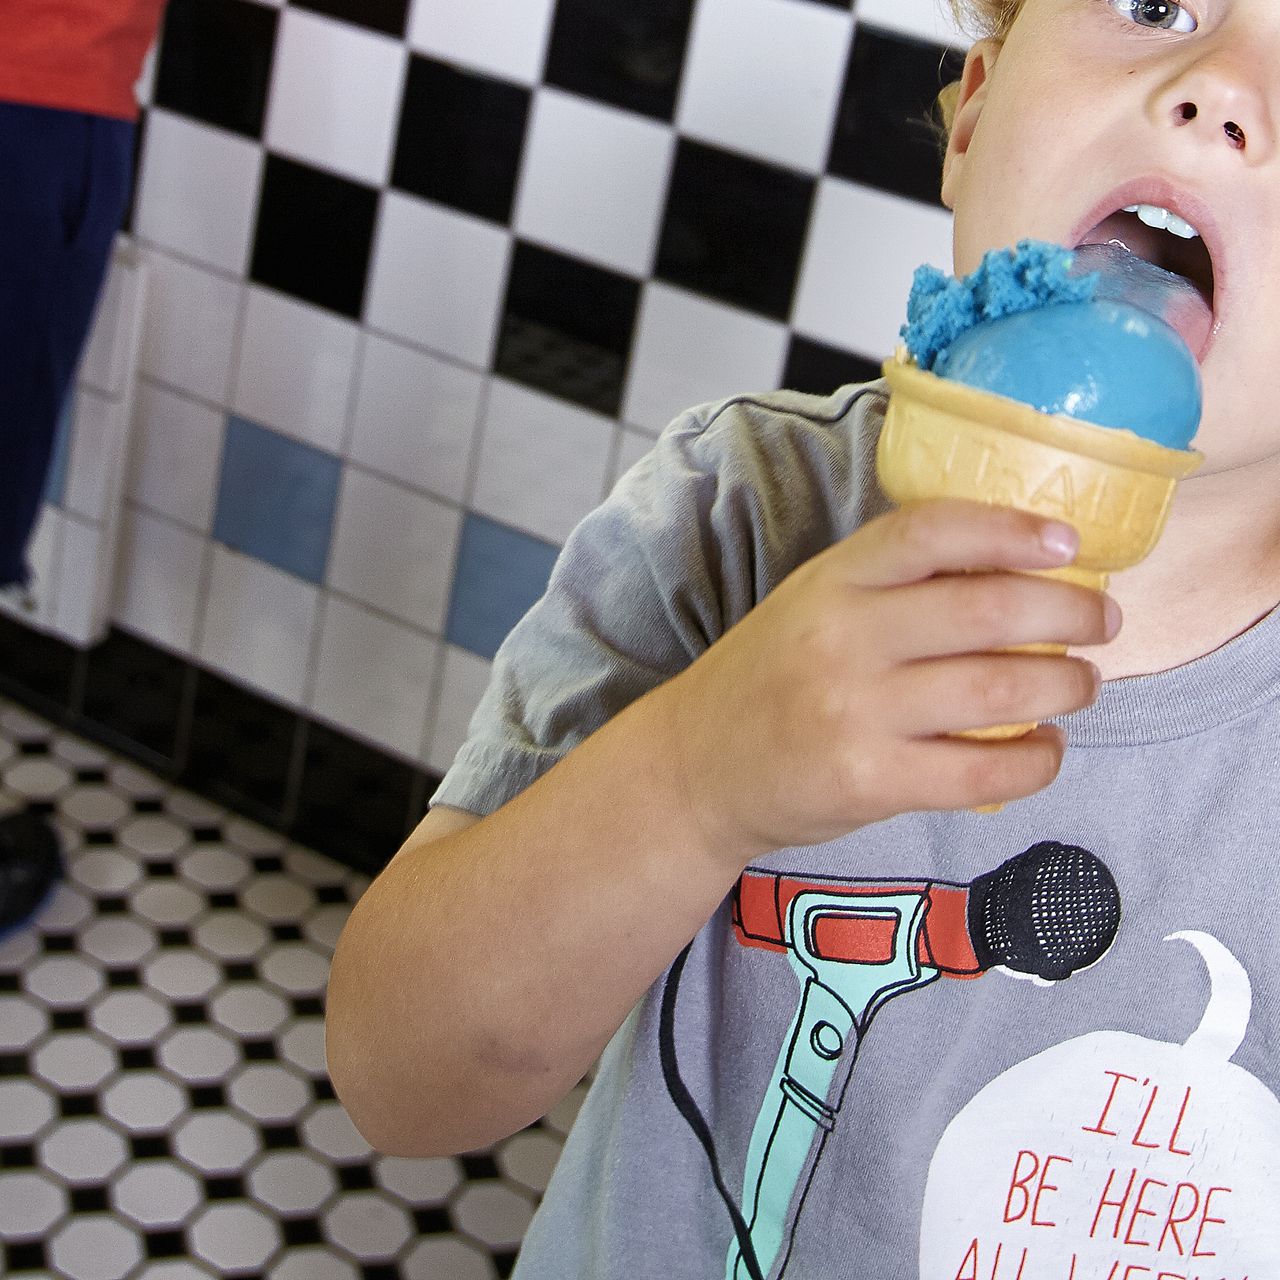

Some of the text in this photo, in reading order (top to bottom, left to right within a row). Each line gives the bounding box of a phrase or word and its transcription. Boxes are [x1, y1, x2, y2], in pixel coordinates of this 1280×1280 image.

[1081, 1070, 1192, 1156] I'LL
[1003, 1150, 1233, 1257] BE HERE
